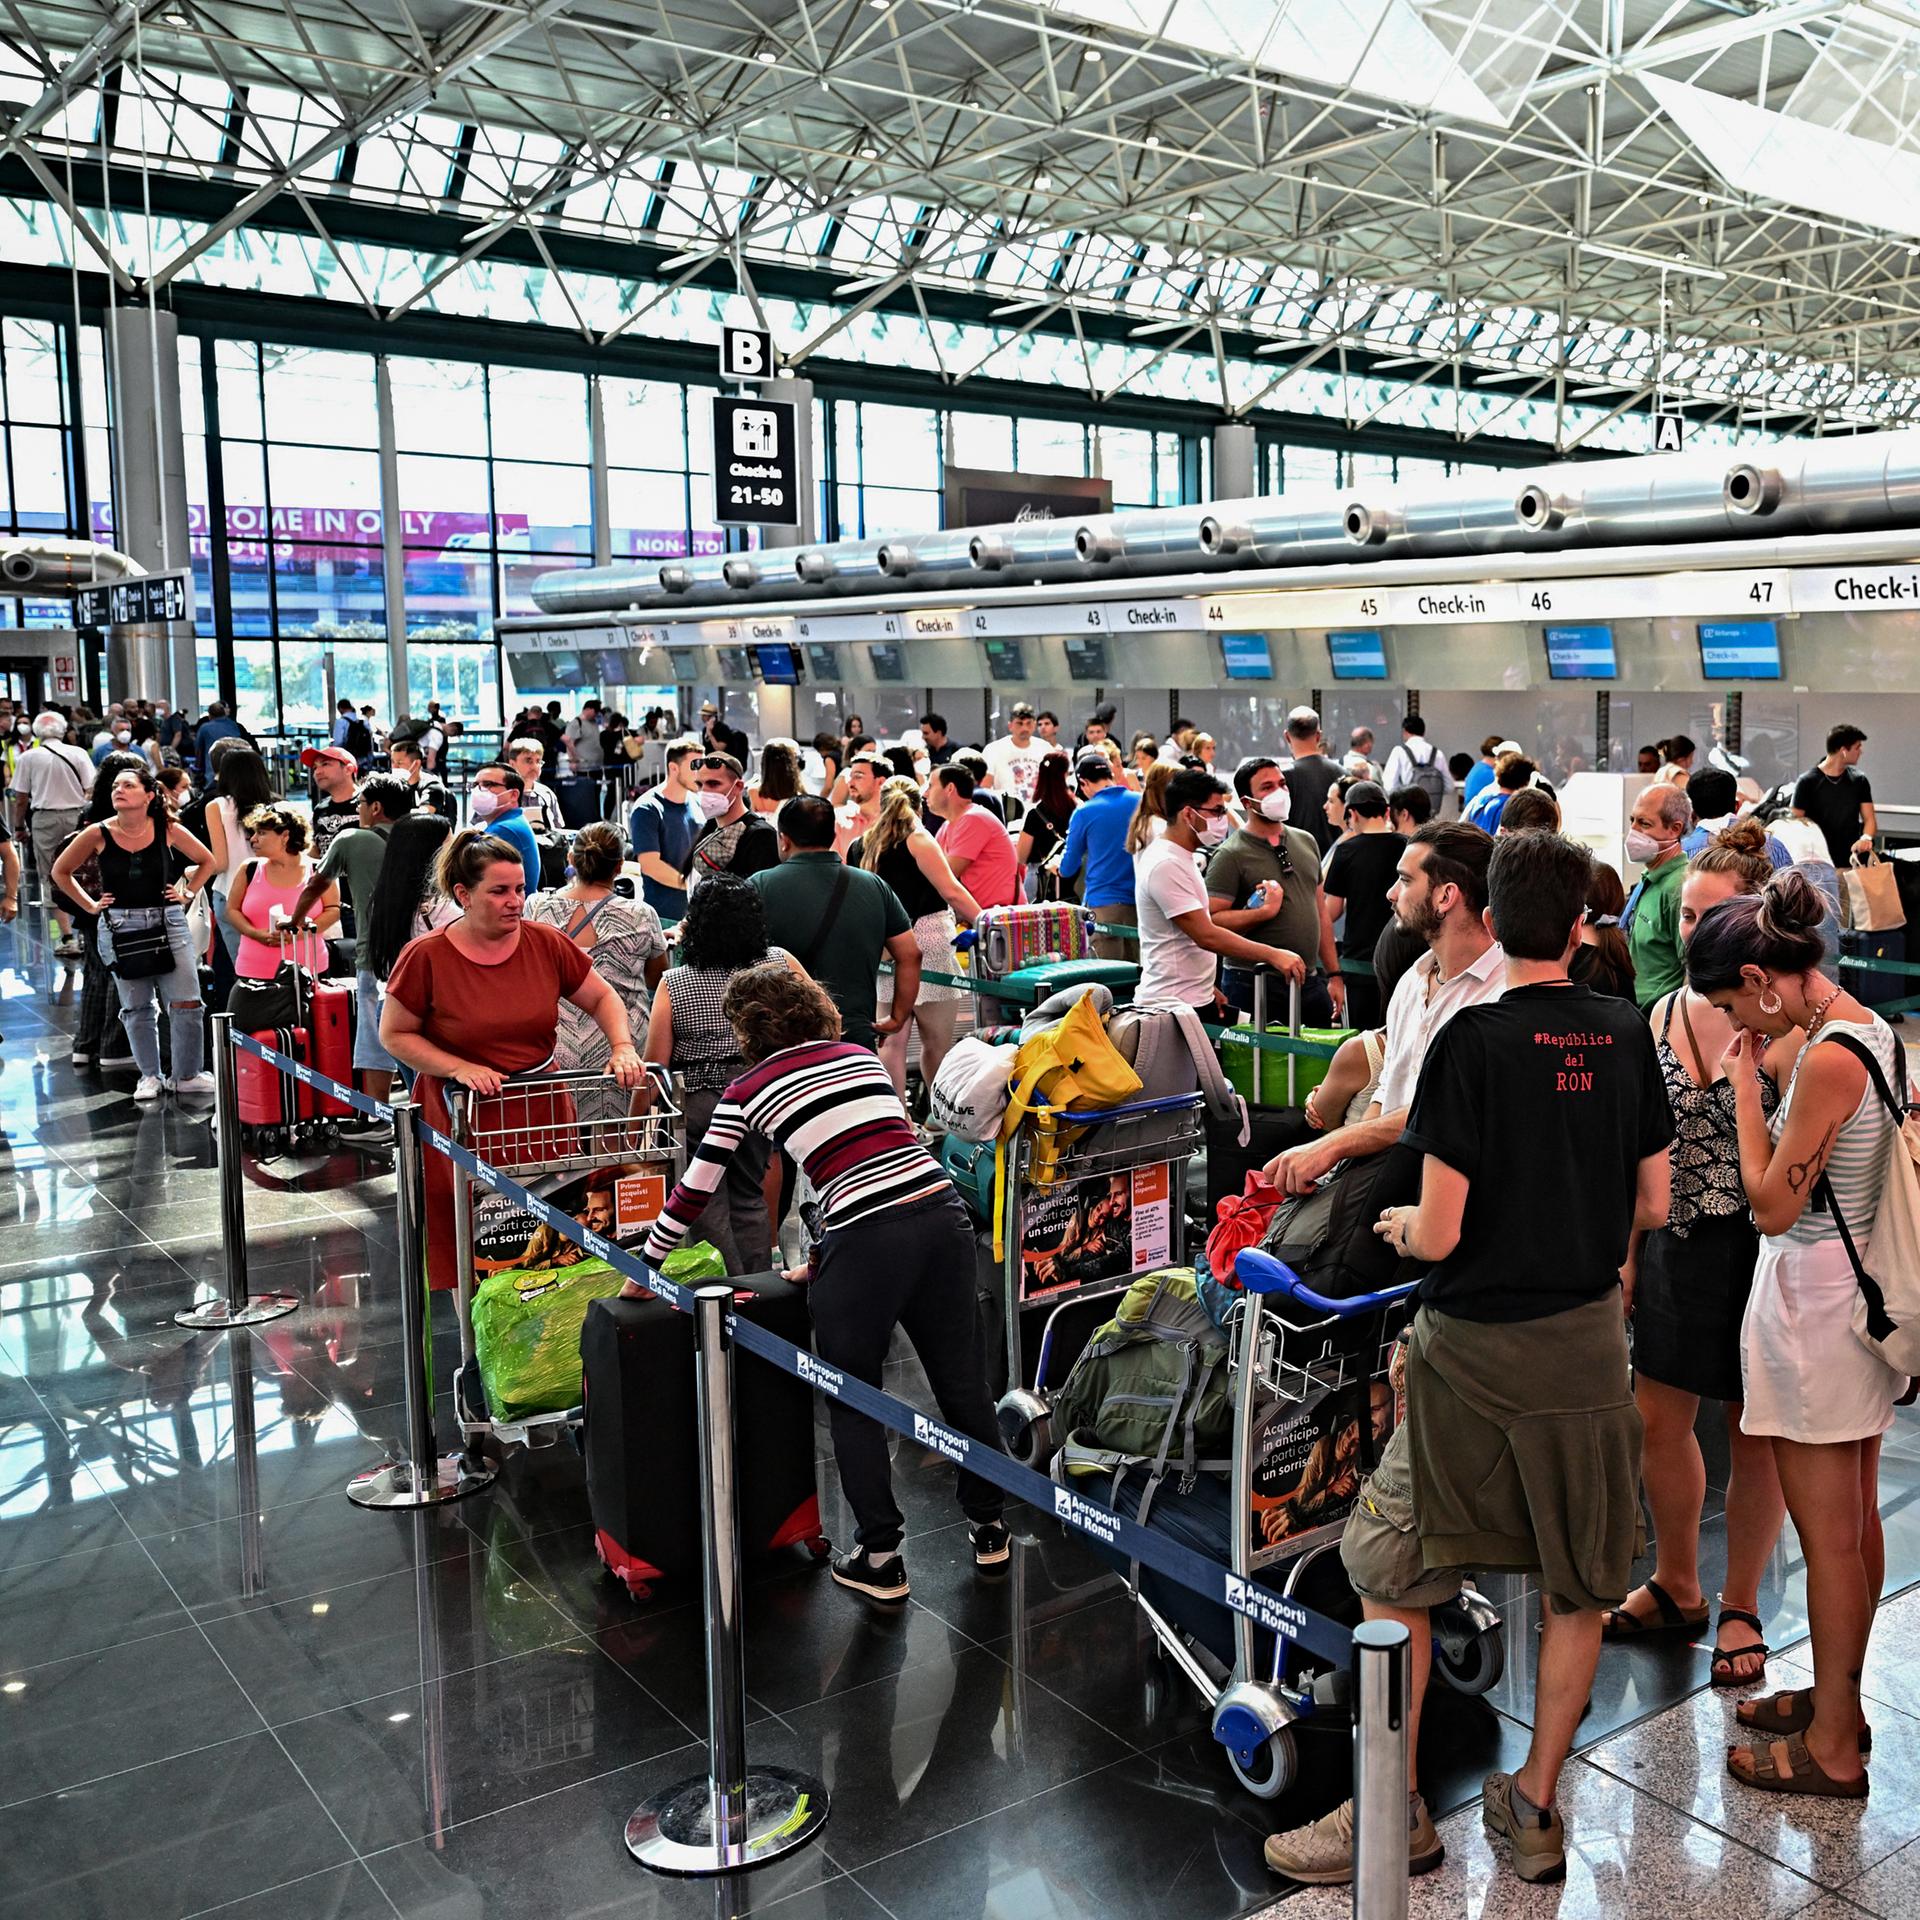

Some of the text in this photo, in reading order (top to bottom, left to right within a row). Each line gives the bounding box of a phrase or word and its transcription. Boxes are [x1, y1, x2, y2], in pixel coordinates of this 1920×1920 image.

[733, 331, 763, 374] B
[1658, 417, 1680, 451] A
[730, 463, 782, 479] Check-in
[730, 486, 783, 506] 21-50
[315, 511, 346, 532] IN
[356, 511, 435, 534] OLY
[636, 538, 724, 553] NON-TO
[1531, 591, 1552, 611] 46
[1750, 582, 1773, 603] 47
[1208, 605, 1223, 621] 44
[1360, 598, 1378, 616] 45
[1418, 594, 1486, 615] Check-in
[916, 618, 953, 633] Check-in
[976, 616, 987, 630] 42
[1087, 611, 1100, 626] 43
[1127, 608, 1177, 625] Check-in
[752, 625, 783, 639] Check-in
[800, 624, 809, 637] 40
[886, 620, 896, 634] 41
[631, 630, 656, 643] Check-in
[1706, 651, 1739, 659] Check-in
[1839, 955, 1868, 968] Alitalia
[1219, 1028, 1250, 1044] Alitalia
[1534, 1032, 1613, 1049] #República
[1565, 1053, 1585, 1067] del
[1556, 1072, 1593, 1091] RON
[620, 1188, 648, 1198] acquisti
[480, 1199, 515, 1210] Acqu
[620, 1202, 650, 1212] risparmi
[1027, 1194, 1079, 1214] in anticipo
[480, 1207, 534, 1222] in antic
[1027, 1207, 1077, 1227] e parti con
[480, 1219, 544, 1235] e parti con
[1028, 1219, 1074, 1239] un sorriso
[480, 1230, 542, 1246] un sorriso
[656, 1274, 679, 1296] Aeroporti
[662, 1287, 677, 1304] Roma
[810, 1358, 843, 1386] Aeroporti
[810, 1371, 816, 1383] di
[817, 1375, 839, 1395] Roma
[1263, 1415, 1311, 1438] Acquista
[929, 1421, 969, 1452] Aeroporti
[1263, 1426, 1319, 1453] in anticipo
[929, 1435, 963, 1462] di Roma
[1262, 1441, 1316, 1467] e parti con
[1262, 1456, 1313, 1480] un sorriso
[1072, 1495, 1120, 1531] Aeroporti
[1072, 1511, 1114, 1543] di Roma
[1246, 1584, 1306, 1626] Aeroporti
[1246, 1601, 1297, 1639] di Roma
